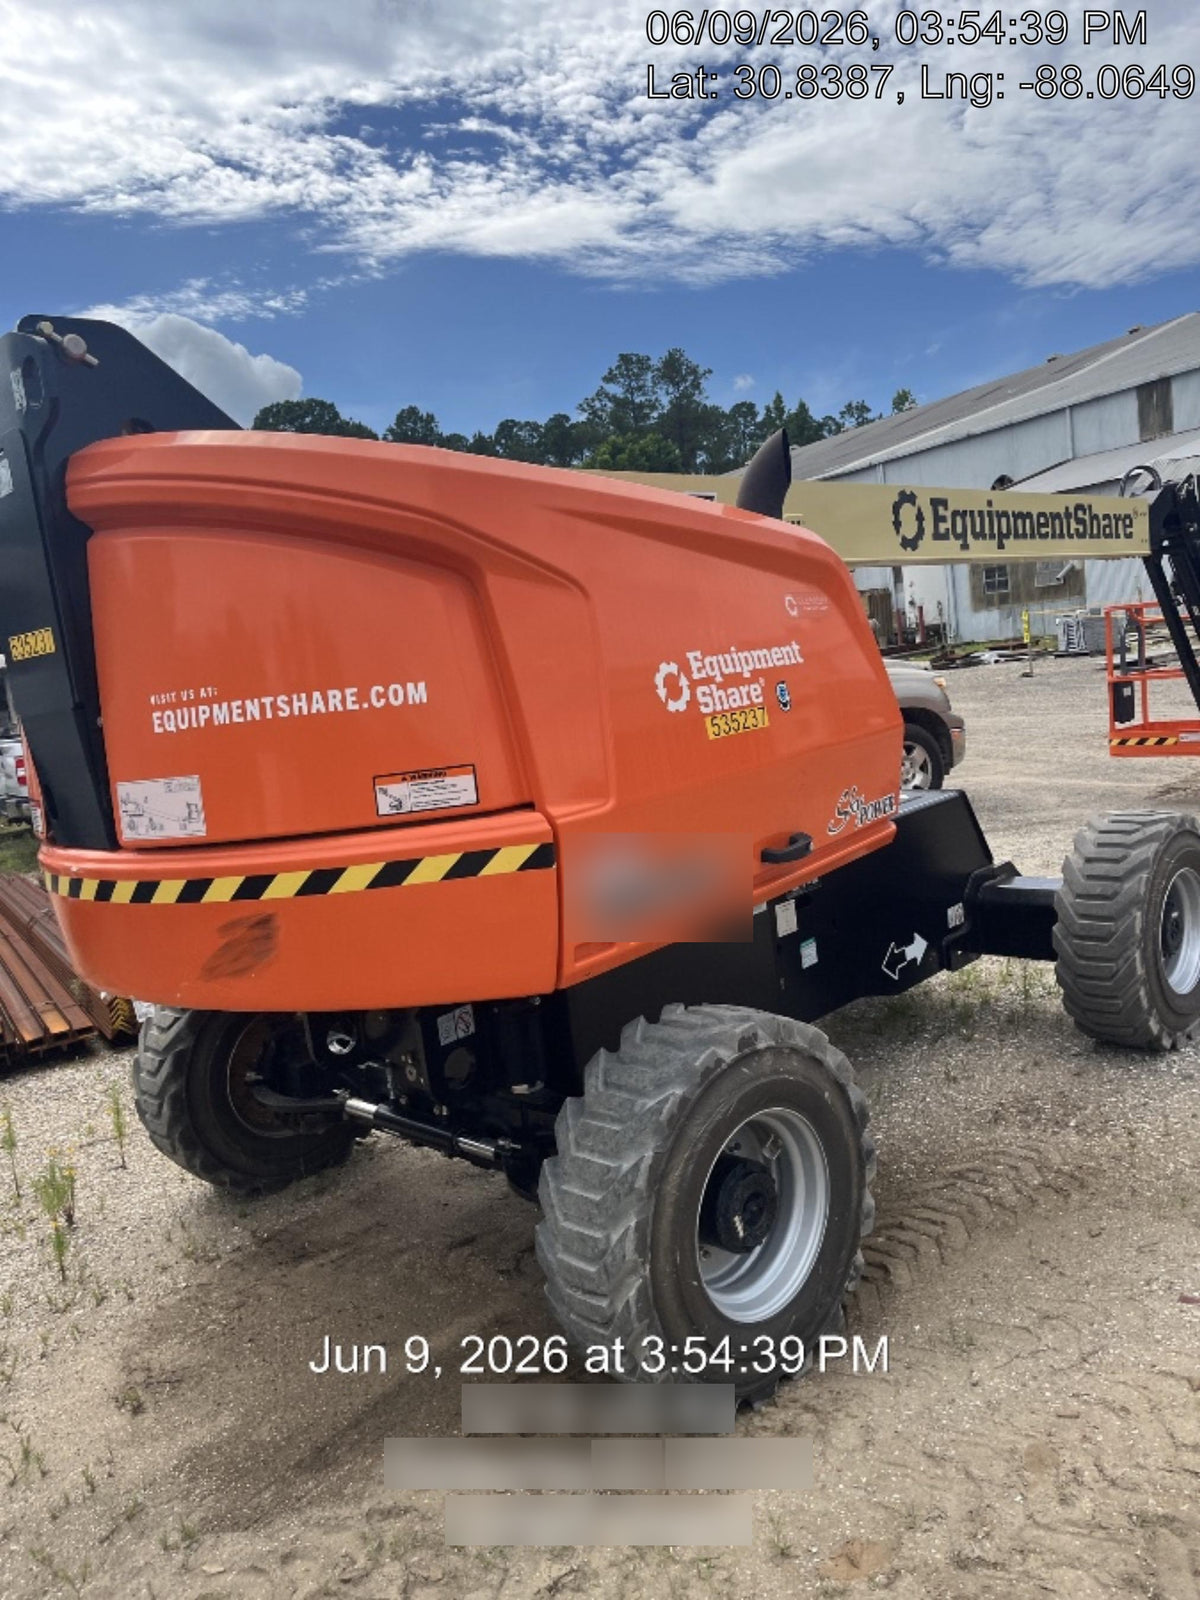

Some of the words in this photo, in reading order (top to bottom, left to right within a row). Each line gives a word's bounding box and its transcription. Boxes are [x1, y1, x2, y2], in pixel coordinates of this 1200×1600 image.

[930, 498, 1134, 550] EquipmentShare
[686, 640, 804, 682] Equipment
[152, 680, 428, 735] EQUIPMENTSHARE.COM
[696, 683, 764, 714] Share
[710, 707, 767, 738] 535237
